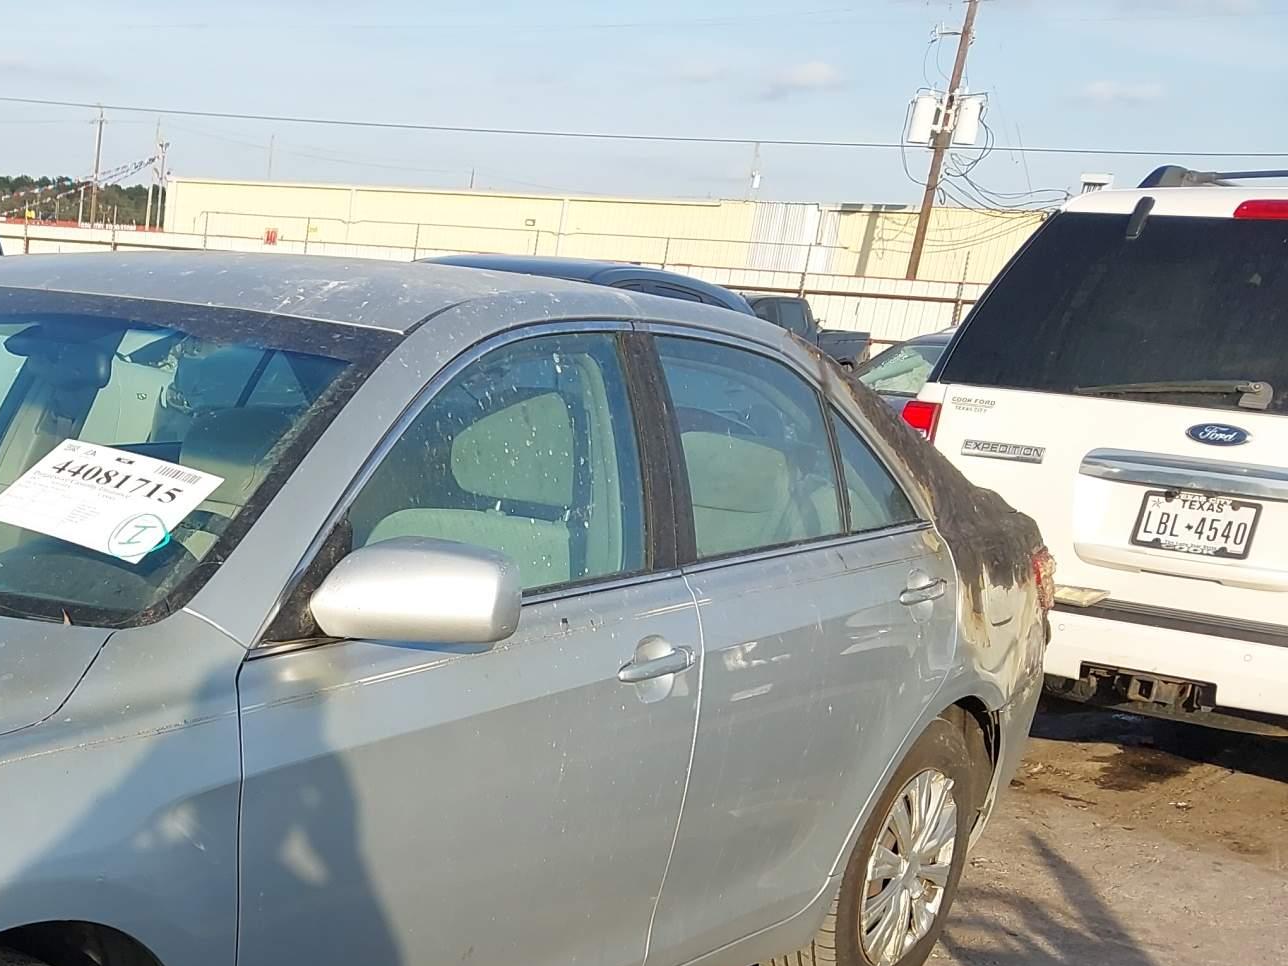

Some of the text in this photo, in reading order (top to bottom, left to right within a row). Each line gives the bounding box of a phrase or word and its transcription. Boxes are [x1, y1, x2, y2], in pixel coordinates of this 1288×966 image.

[952, 396, 996, 407] COOK FORD
[1199, 425, 1238, 442] Ford
[963, 440, 1044, 458] EXPEDITION
[51, 459, 184, 504] 44081715
[1181, 499, 1225, 514] TEXAS
[1142, 510, 1248, 546] LBL 4540
